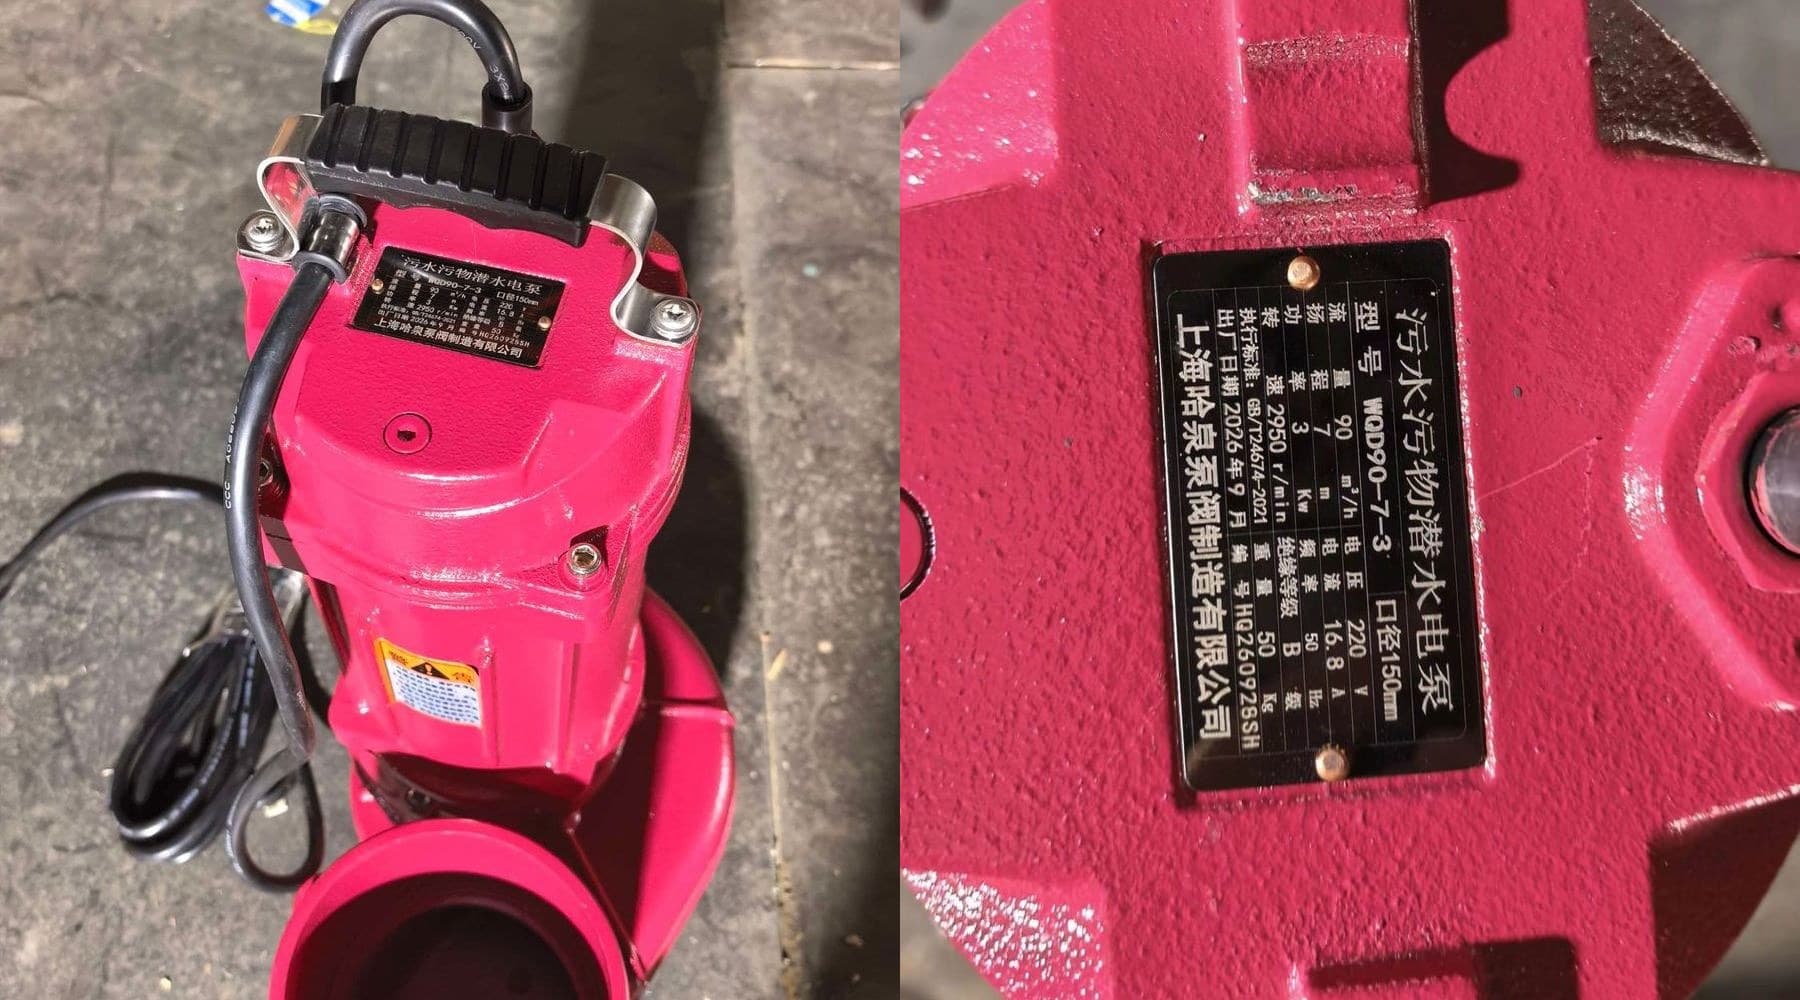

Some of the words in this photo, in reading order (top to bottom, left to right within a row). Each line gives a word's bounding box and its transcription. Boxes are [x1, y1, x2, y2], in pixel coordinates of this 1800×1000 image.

[403, 257, 543, 295] 污水污物潜水电泵
[374, 317, 523, 358] 上海哈泉泵阀制造有限公司
[1268, 404, 1288, 453] 2950
[1292, 422, 1310, 434] 3
[1313, 424, 1332, 436] 7
[1334, 414, 1353, 440] 90
[1247, 398, 1268, 524] GB/T24674-2021
[1363, 397, 1392, 552] WQD90-7-3
[1272, 463, 1290, 523] r/min
[1320, 487, 1331, 500] m
[1396, 308, 1454, 715] 污水污物潜水电泵
[1176, 314, 1232, 739] 上海哈泉泵阀制造有限公司
[1276, 536, 1300, 618] 绝缘等级
[1257, 631, 1277, 658] 50
[1282, 642, 1302, 657] B
[1304, 632, 1319, 651] 50
[1324, 620, 1345, 671] 16.8
[1347, 618, 1368, 658] 220
[1235, 603, 1262, 749] HQ260928SH
[1376, 600, 1403, 721] 口径150mm
[1262, 692, 1278, 712] Kg
[1284, 692, 1303, 712] 级
[1308, 690, 1323, 708] Hz
[1331, 688, 1346, 698] A
[1354, 686, 1370, 696] V
